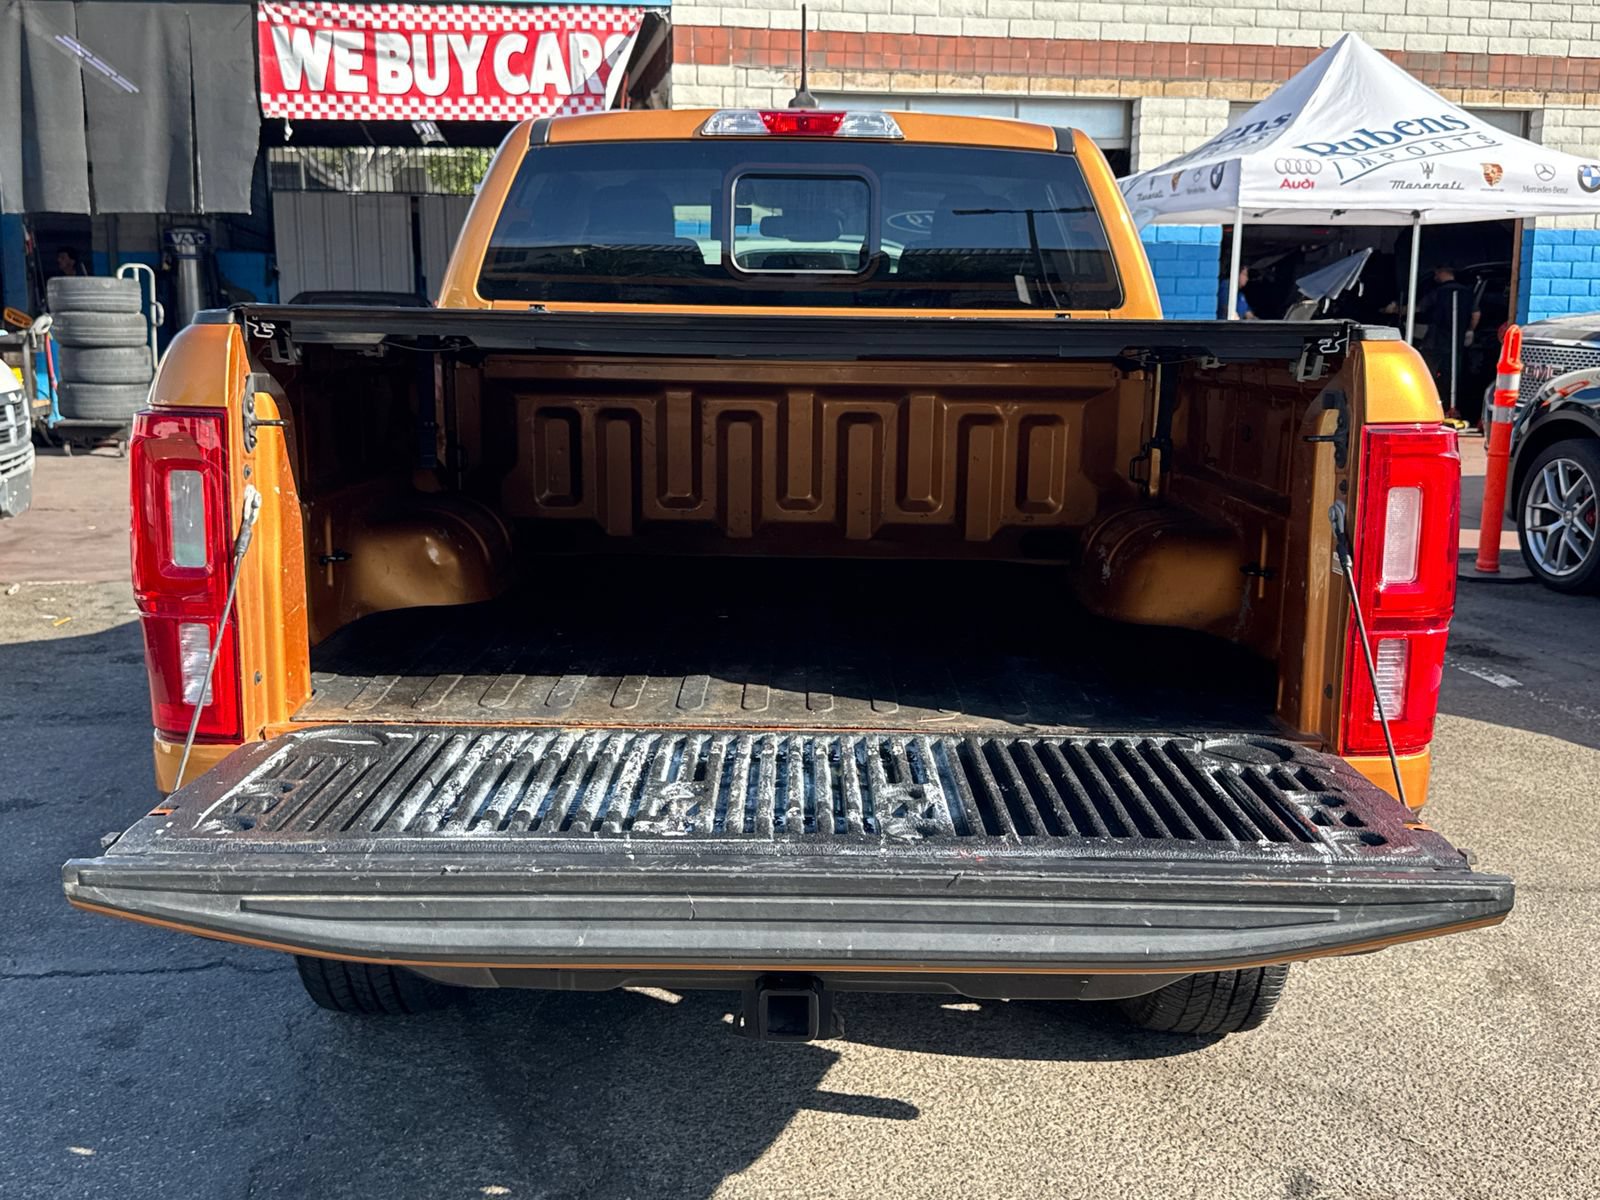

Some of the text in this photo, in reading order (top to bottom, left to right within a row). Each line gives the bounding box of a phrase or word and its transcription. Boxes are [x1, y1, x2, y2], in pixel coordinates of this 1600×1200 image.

[271, 26, 369, 92] WE
[376, 31, 488, 96] BUY
[1292, 113, 1471, 157] Rubens
[1332, 133, 1497, 180] IMPORTS
[1279, 178, 1315, 190] Audi
[1389, 179, 1465, 191] Maserati
